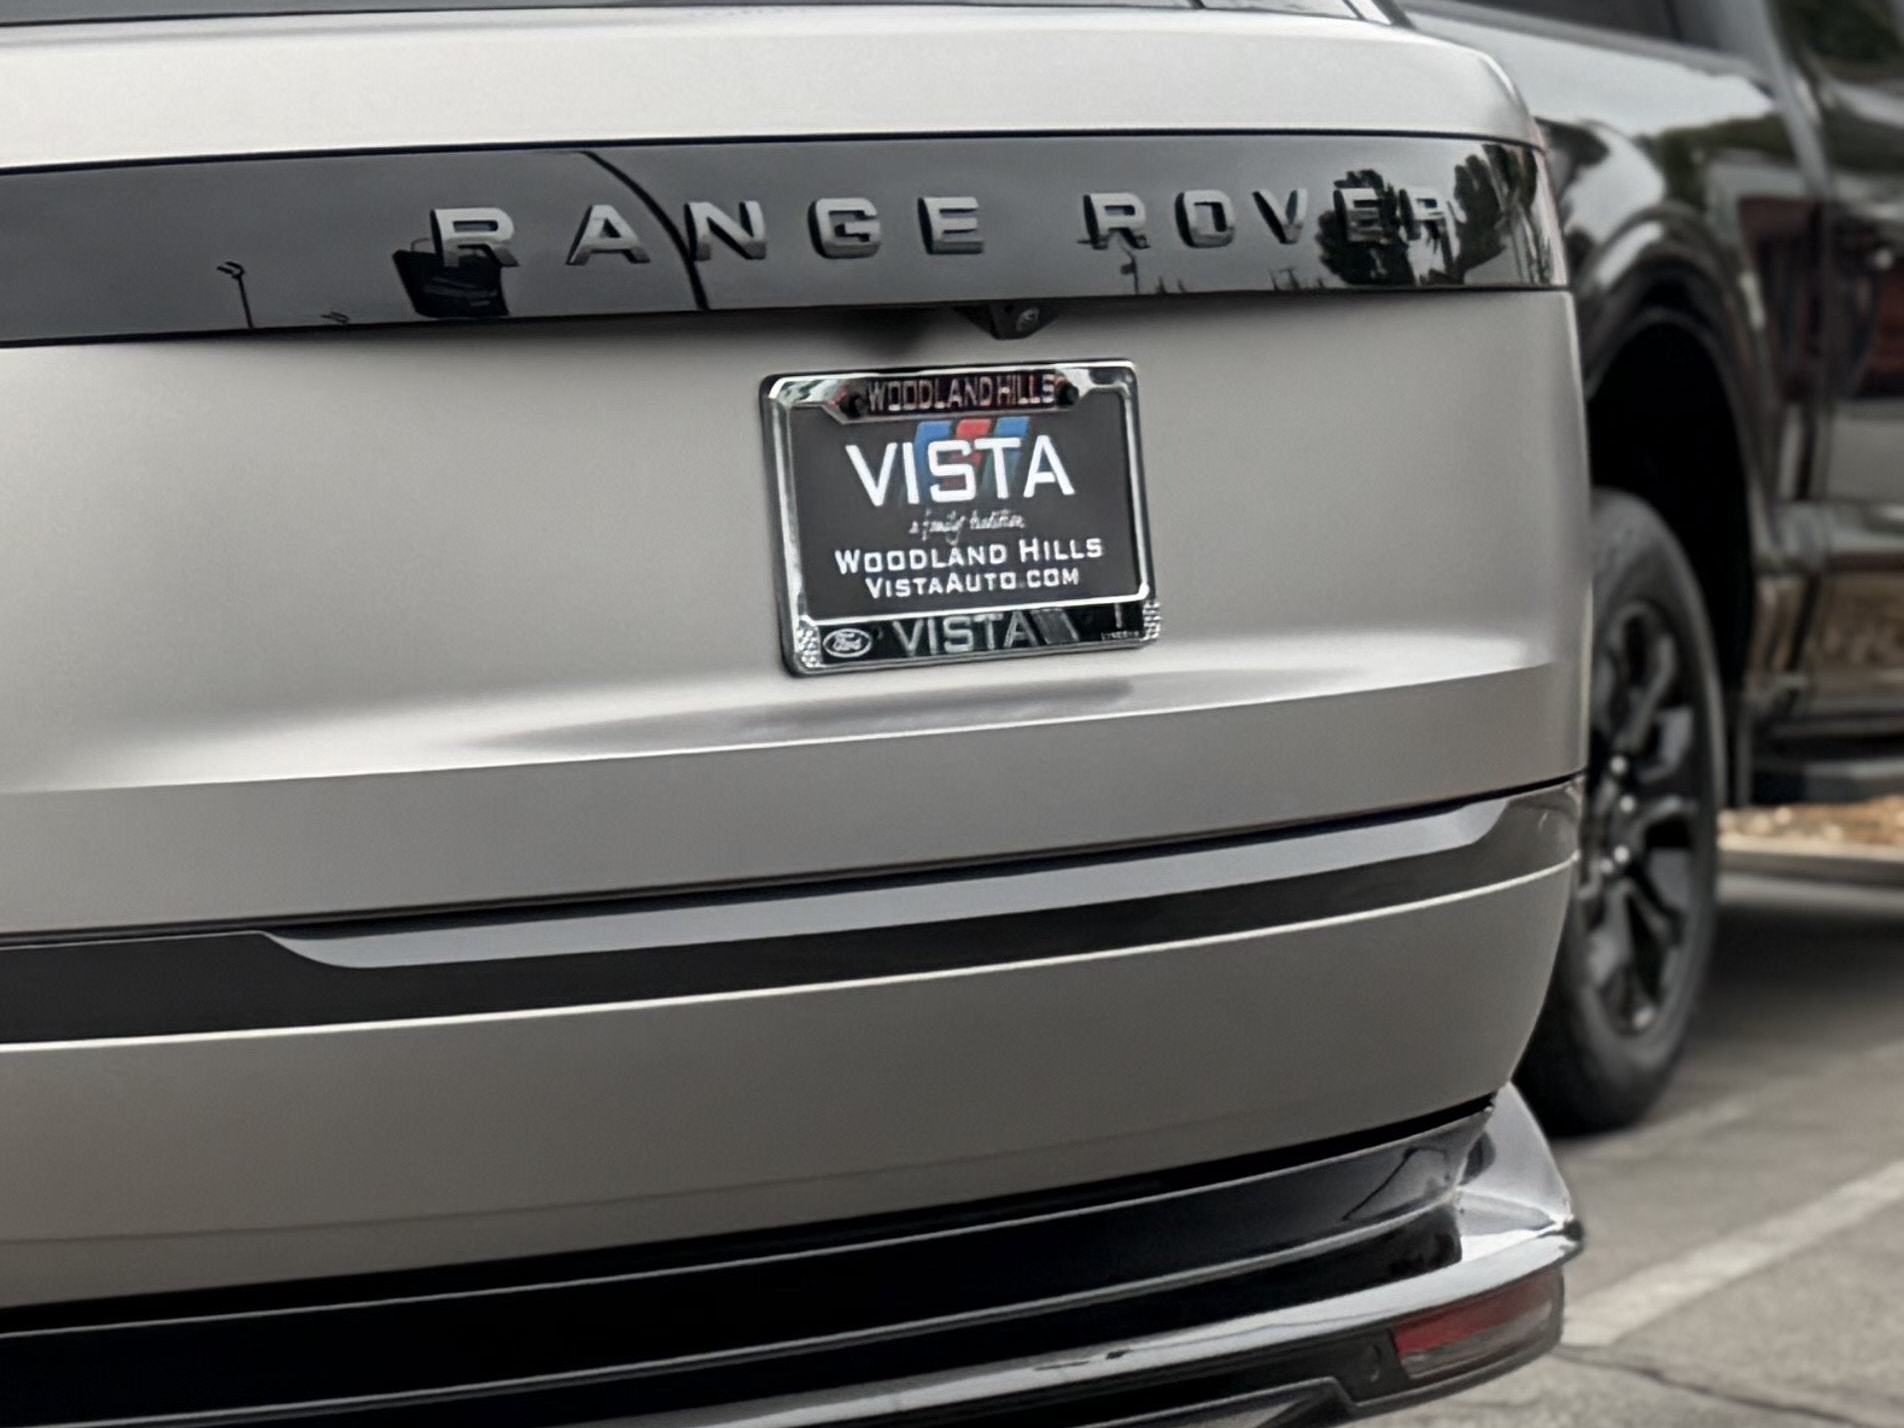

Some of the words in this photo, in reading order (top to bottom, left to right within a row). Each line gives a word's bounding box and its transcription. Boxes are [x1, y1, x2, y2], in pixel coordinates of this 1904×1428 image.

[431, 196, 985, 268] RANGE
[1080, 187, 1454, 251] ROVER
[868, 375, 993, 412] WOODLAND
[996, 373, 1055, 406] HILLS
[845, 434, 1075, 507] VISTA
[894, 610, 1039, 657] VISTA
